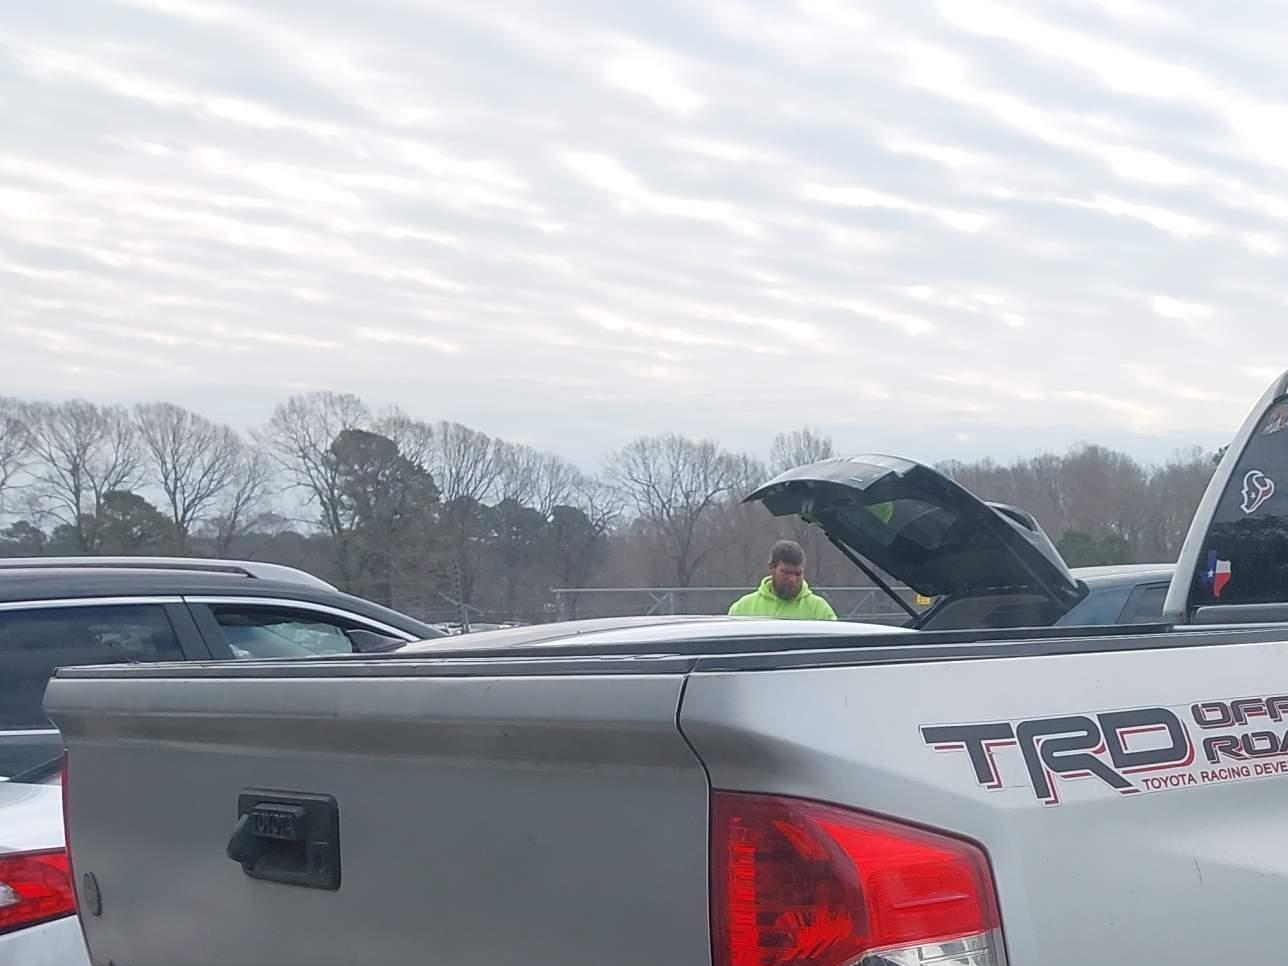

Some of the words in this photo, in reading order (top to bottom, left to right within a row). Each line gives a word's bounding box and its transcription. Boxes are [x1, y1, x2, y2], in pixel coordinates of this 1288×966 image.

[919, 706, 1195, 806] TRD
[1142, 773, 1198, 790] TOYOTA
[1201, 763, 1250, 782] RACING
